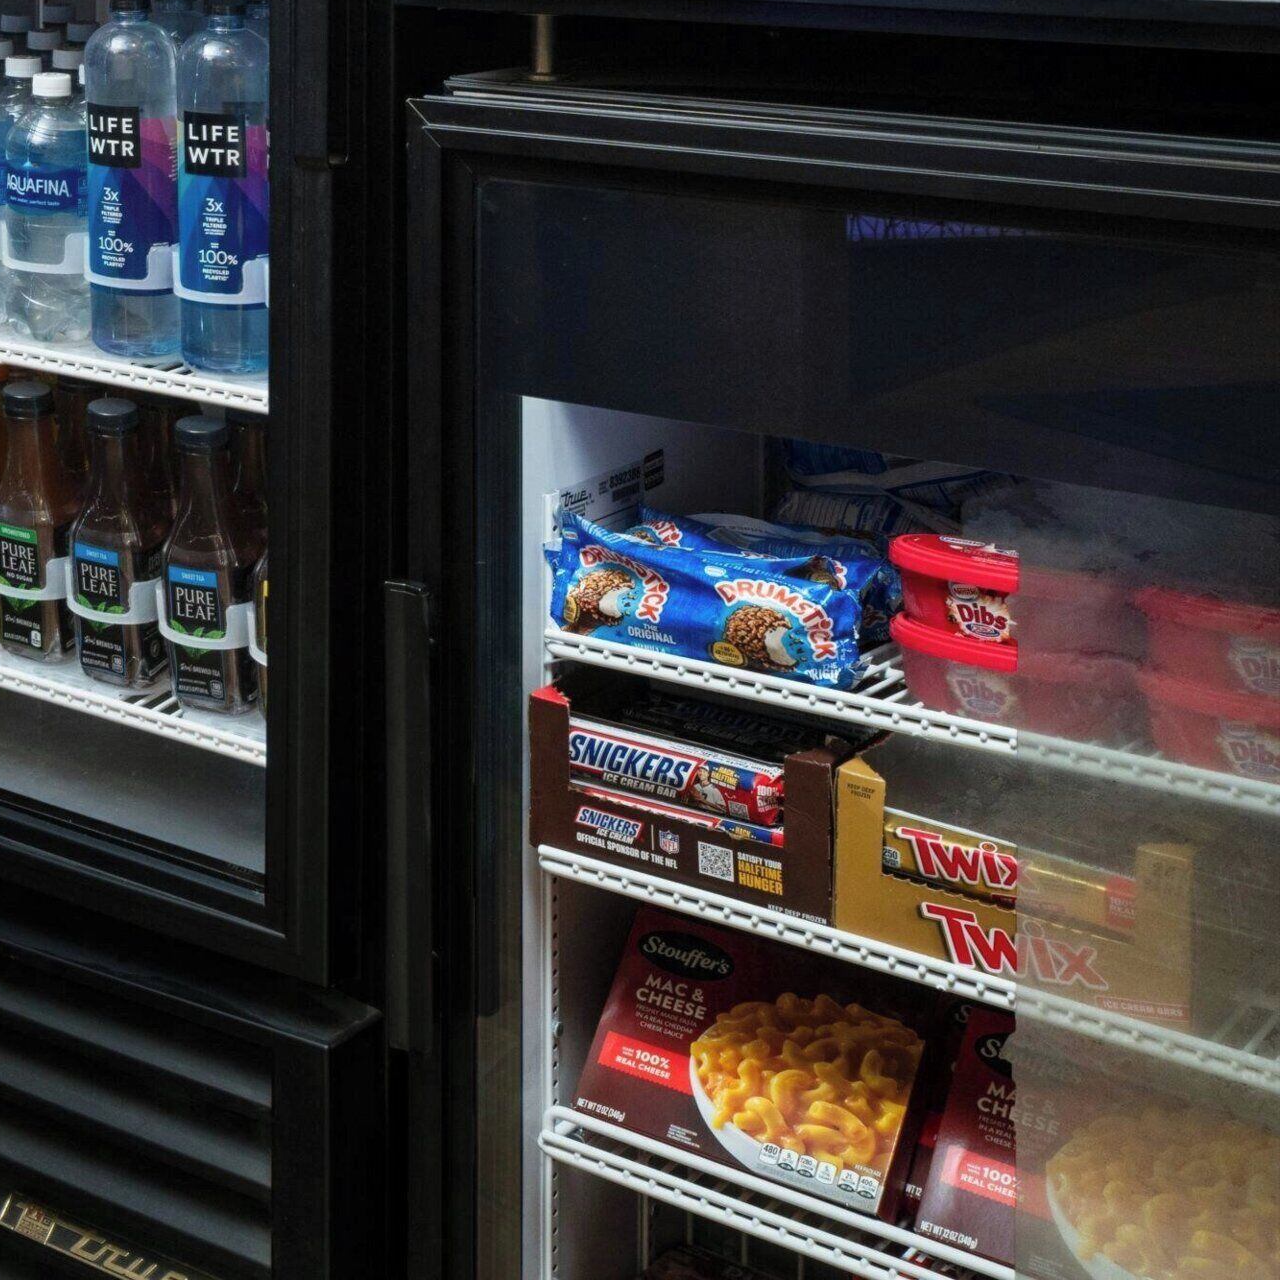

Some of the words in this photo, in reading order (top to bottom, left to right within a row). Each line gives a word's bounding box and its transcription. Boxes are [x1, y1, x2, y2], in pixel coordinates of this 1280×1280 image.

[90, 114, 133, 134] LIFE
[189, 123, 239, 143] LIFE
[90, 137, 134, 157] WTR
[189, 146, 239, 166] WTR
[6, 172, 69, 198] AQUAFINA
[205, 198, 223, 212] 3x
[98, 236, 133, 253] 100%
[198, 249, 238, 265] 100%
[1, 541, 35, 560] PURE
[16, 573, 33, 582] SUGAR
[81, 564, 117, 582] PURE
[579, 545, 669, 623] DRUMSTICK
[715, 578, 838, 661] DRUMSTICK
[957, 603, 1007, 630] Dibs
[627, 626, 676, 645] ORIGINAL
[643, 623, 658, 632] THE
[570, 732, 696, 790] SNICKERS
[602, 772, 617, 784] ICE
[618, 775, 655, 793] CREAM
[656, 785, 677, 800] BAR
[579, 807, 641, 838] SNICKERS
[597, 827, 606, 836] ICE
[607, 829, 633, 844] CREAM
[576, 832, 605, 849] OFFICIAL
[607, 839, 640, 859] SPONSOR
[651, 852, 664, 865] THE
[665, 857, 678, 869] NFL
[737, 852, 762, 865] SATISFY
[763, 857, 782, 870] YOUR
[738, 860, 782, 882] HALFTIME
[738, 873, 783, 896] HUNGER
[643, 936, 730, 974] Stouffer's
[645, 974, 688, 994] MAC
[692, 988, 704, 1002] &
[636, 988, 707, 1020] CHEESE
[616, 1056, 636, 1070] REAL
[638, 1062, 671, 1079] CHEESE
[635, 1050, 671, 1069] 100%
